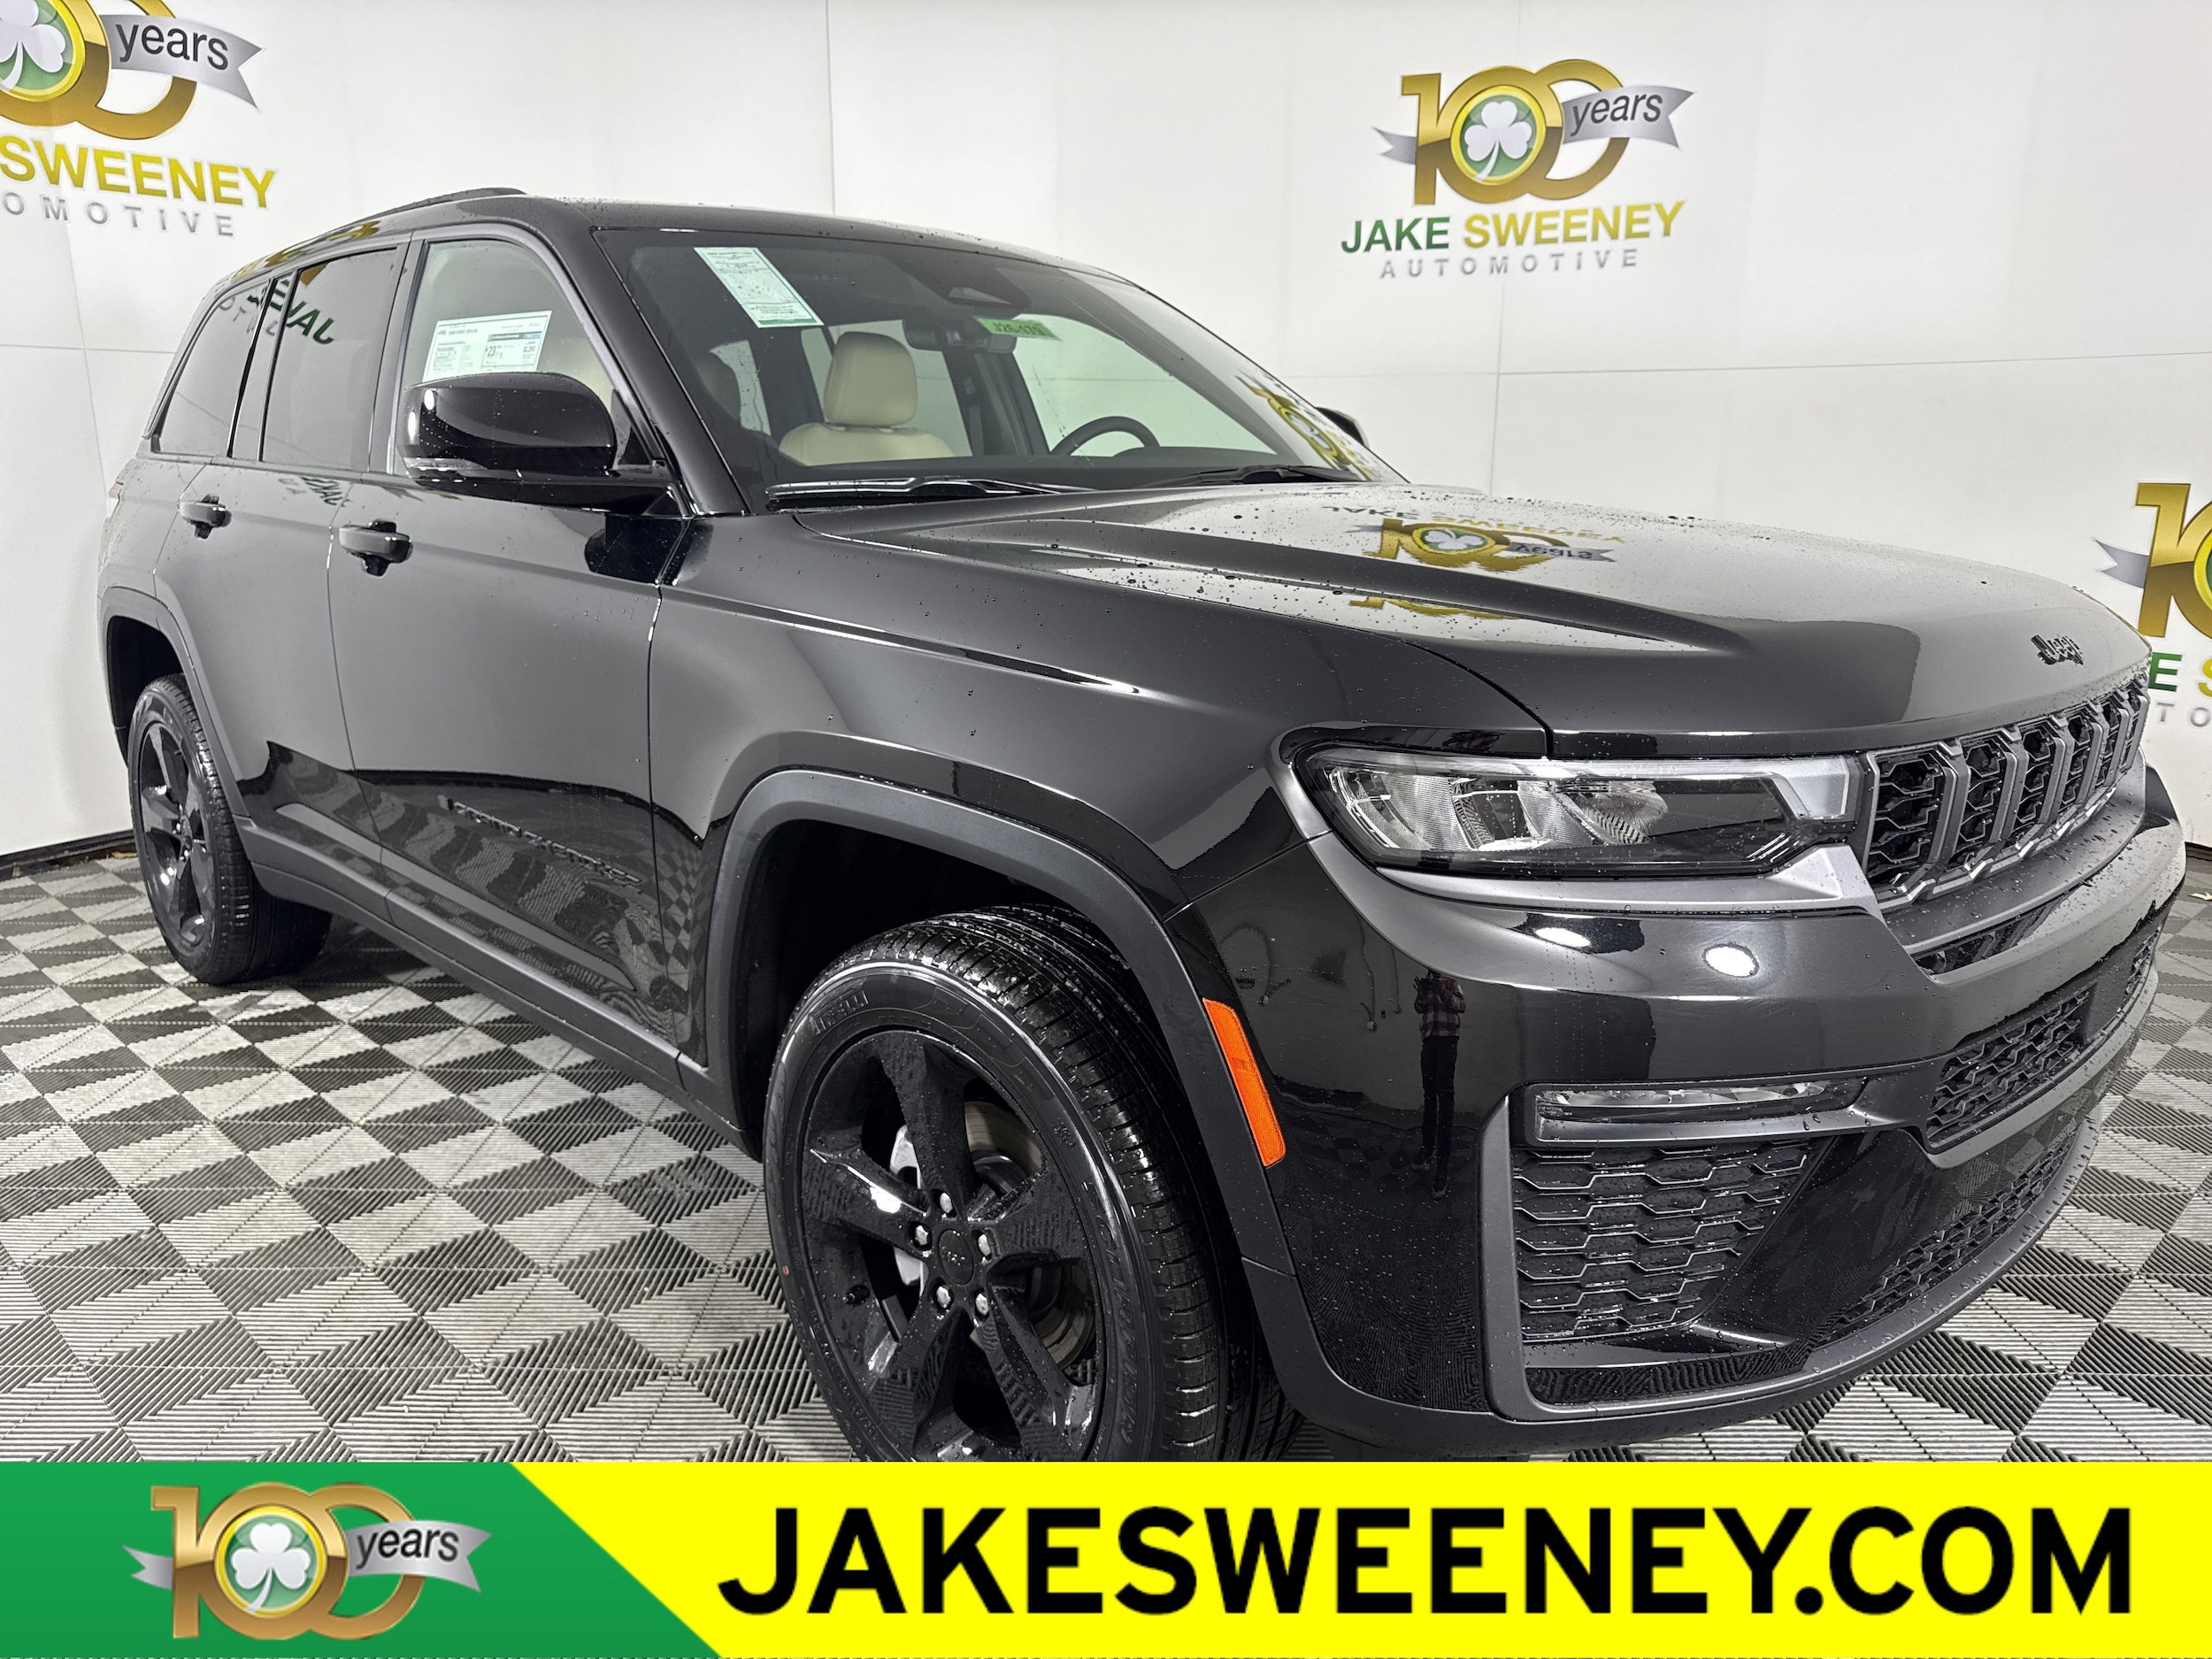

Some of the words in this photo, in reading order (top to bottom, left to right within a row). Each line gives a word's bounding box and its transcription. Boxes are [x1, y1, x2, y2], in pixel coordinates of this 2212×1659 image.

[116, 24, 228, 70] years
[1401, 59, 1631, 204] 100
[1571, 93, 1663, 136] years
[0, 135, 275, 208] SWEENEY
[1341, 217, 1450, 253] JAKE
[1463, 201, 1684, 249] SWEENEY
[1380, 249, 1638, 279] AUTOMOTIVE
